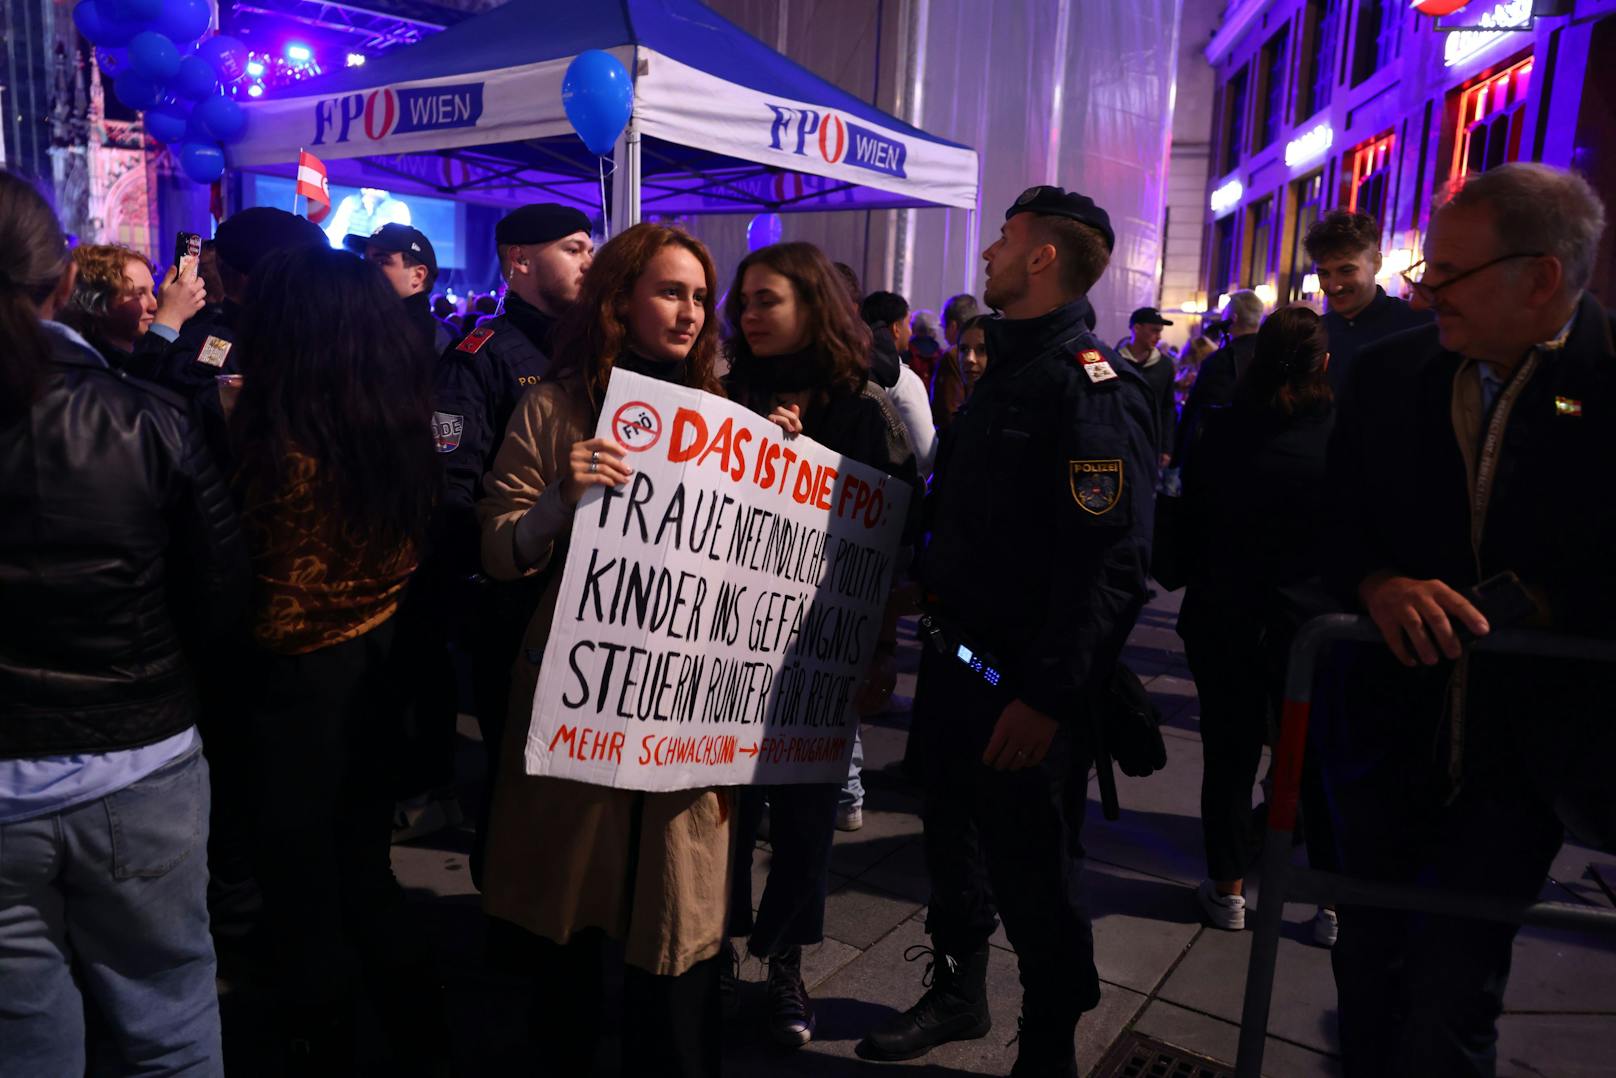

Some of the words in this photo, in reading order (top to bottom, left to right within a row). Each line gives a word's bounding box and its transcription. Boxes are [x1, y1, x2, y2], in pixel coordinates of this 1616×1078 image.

[410, 93, 470, 126] WIEN
[856, 134, 900, 170] WIEN
[517, 375, 542, 387] PO
[623, 412, 652, 439] FPÖ
[667, 406, 752, 482] DAS
[753, 437, 797, 494] IST
[792, 460, 838, 511] DIE
[837, 473, 892, 529] FPÖ:
[1074, 463, 1118, 473] POLIZEI
[599, 471, 832, 588] FRAUENFEINDLICHE
[829, 538, 889, 605] POLITIK
[576, 548, 707, 642] KINDER
[709, 580, 747, 646] INS
[748, 591, 868, 665] GEFÄNGNIS
[562, 640, 705, 724] STEUERN
[701, 657, 773, 726] RUNTER
[771, 661, 806, 728] FÜR
[804, 670, 856, 727] REICHE
[549, 724, 625, 765] MEHR
[639, 735, 737, 766] SCHWACHSINN
[757, 733, 848, 765] FPÖ-PROGRAMM
